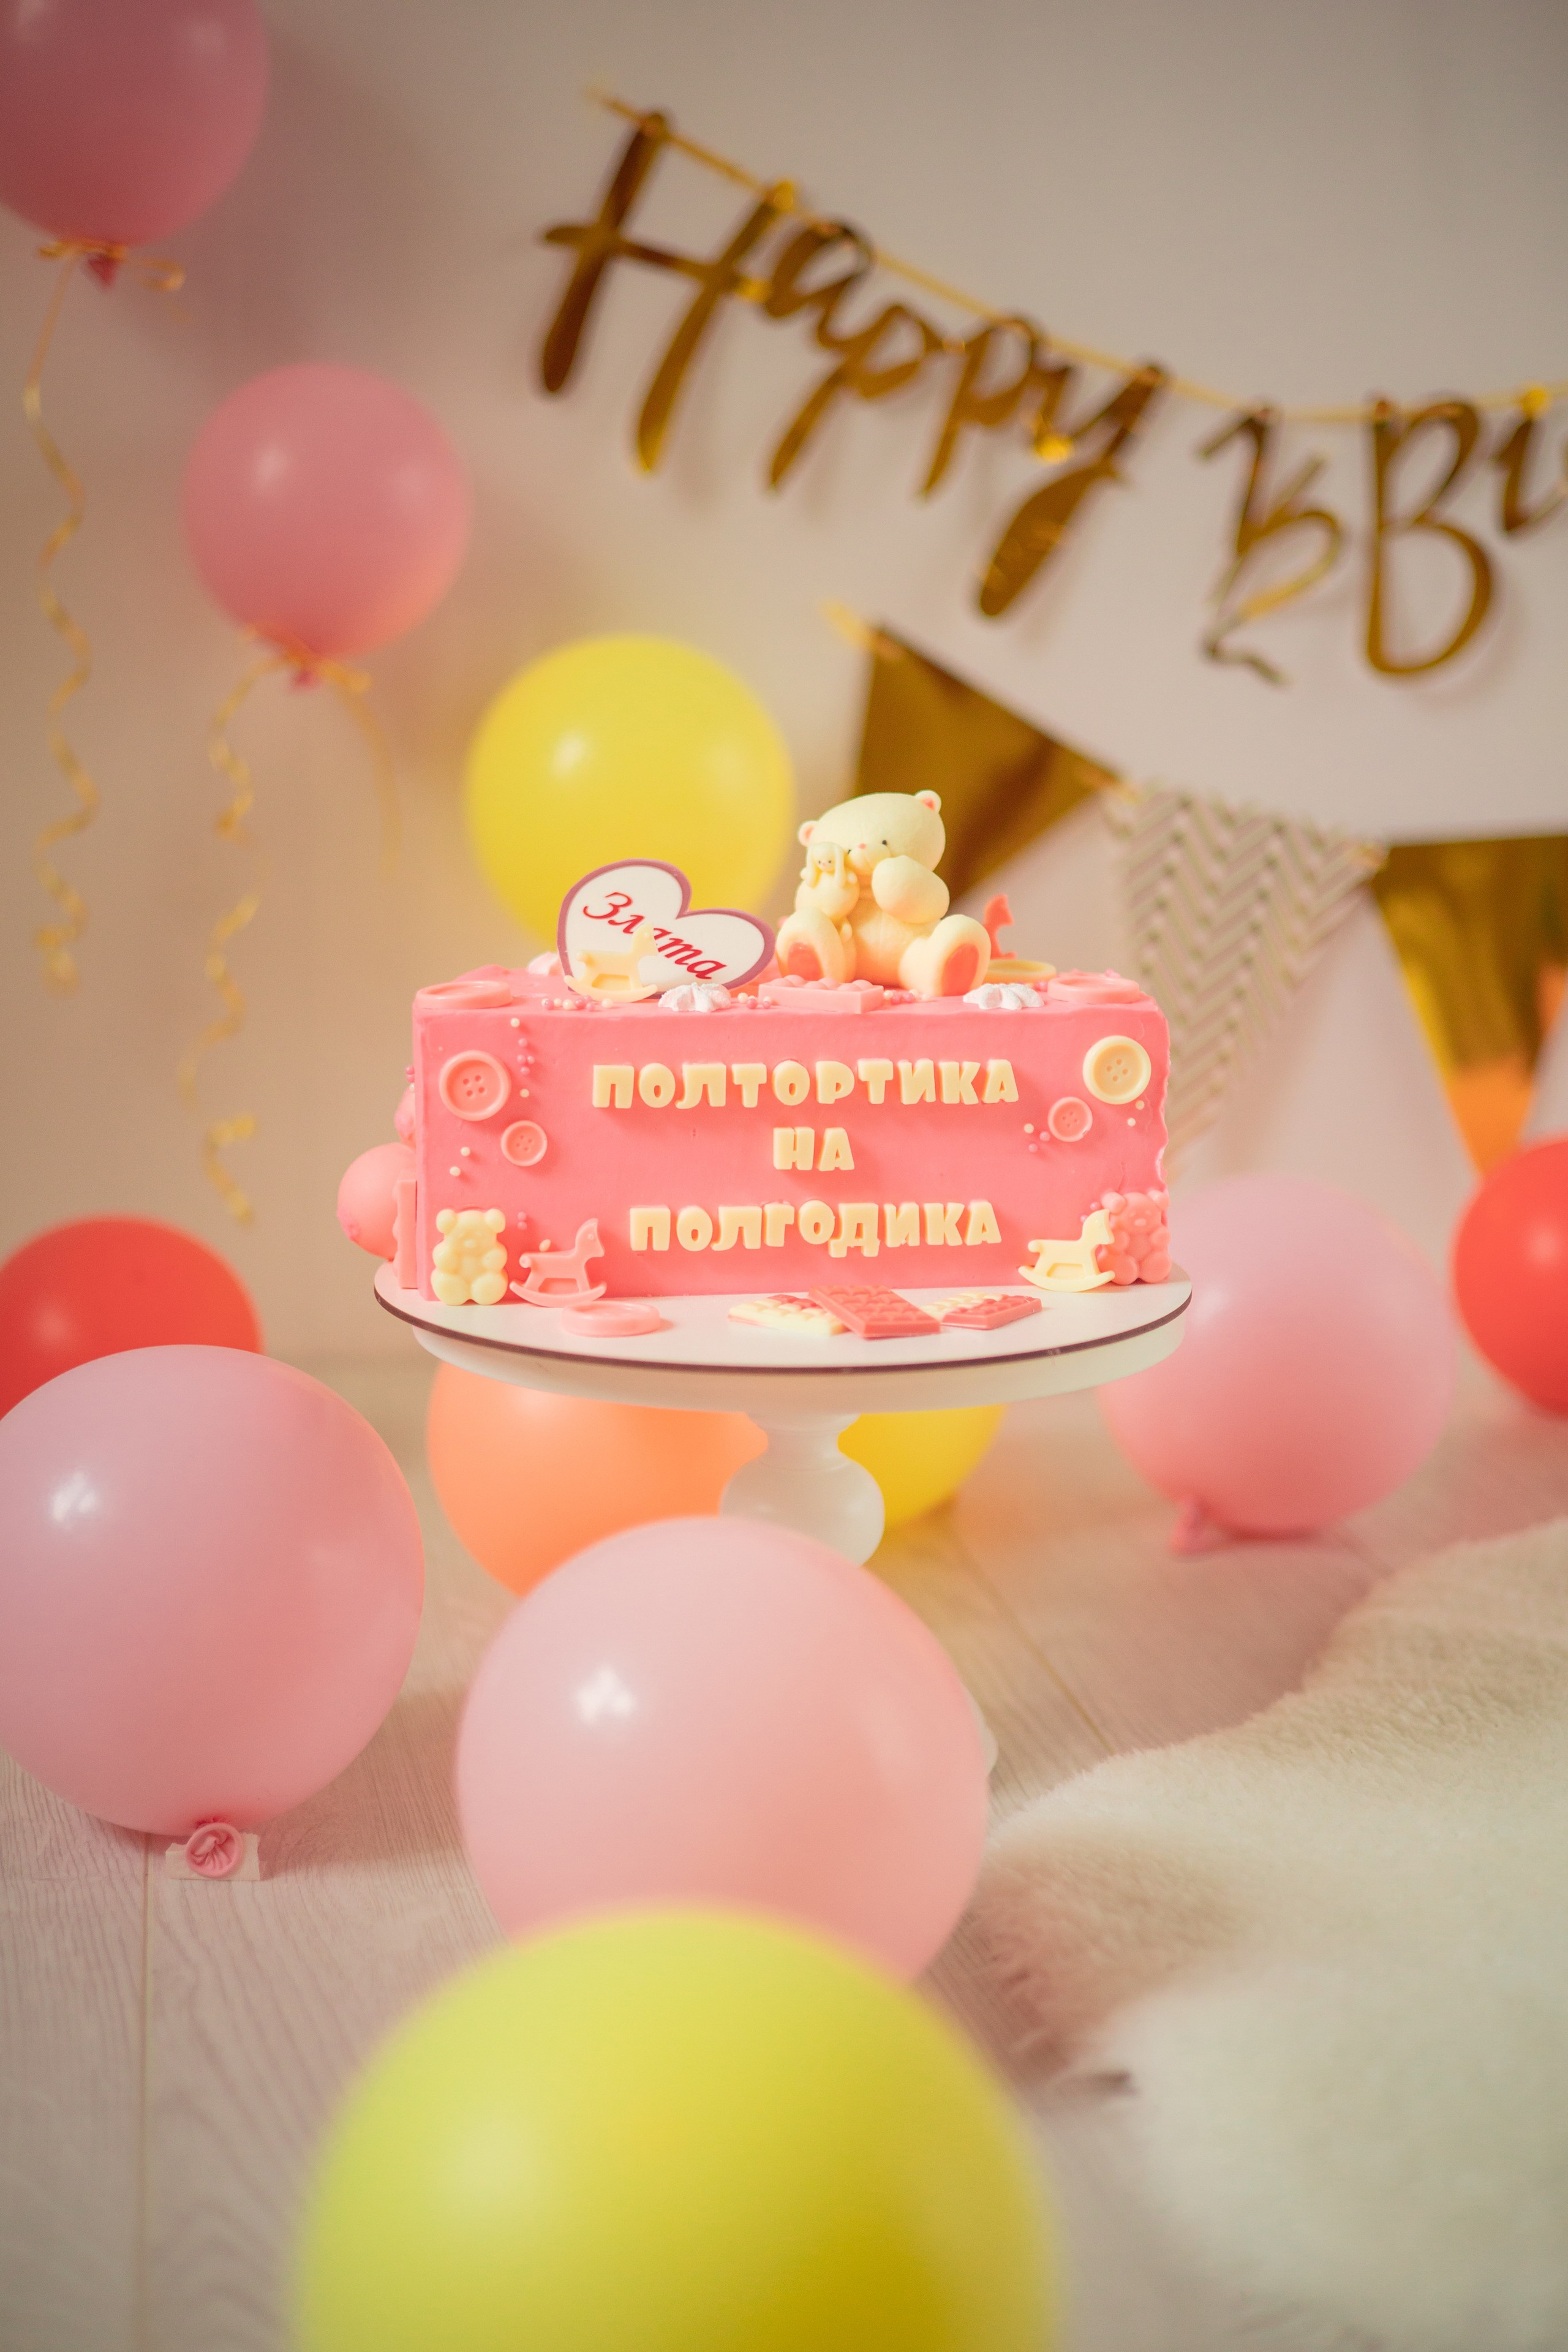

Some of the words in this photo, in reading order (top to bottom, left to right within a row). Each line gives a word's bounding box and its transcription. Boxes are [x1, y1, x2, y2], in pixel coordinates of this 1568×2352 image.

[543, 113, 1169, 617] Happy
[592, 1058, 1019, 1109] ПОЛТОРТИКА
[773, 1127, 855, 1171] НА
[630, 1199, 1002, 1257] ПОЛГОДИКА
